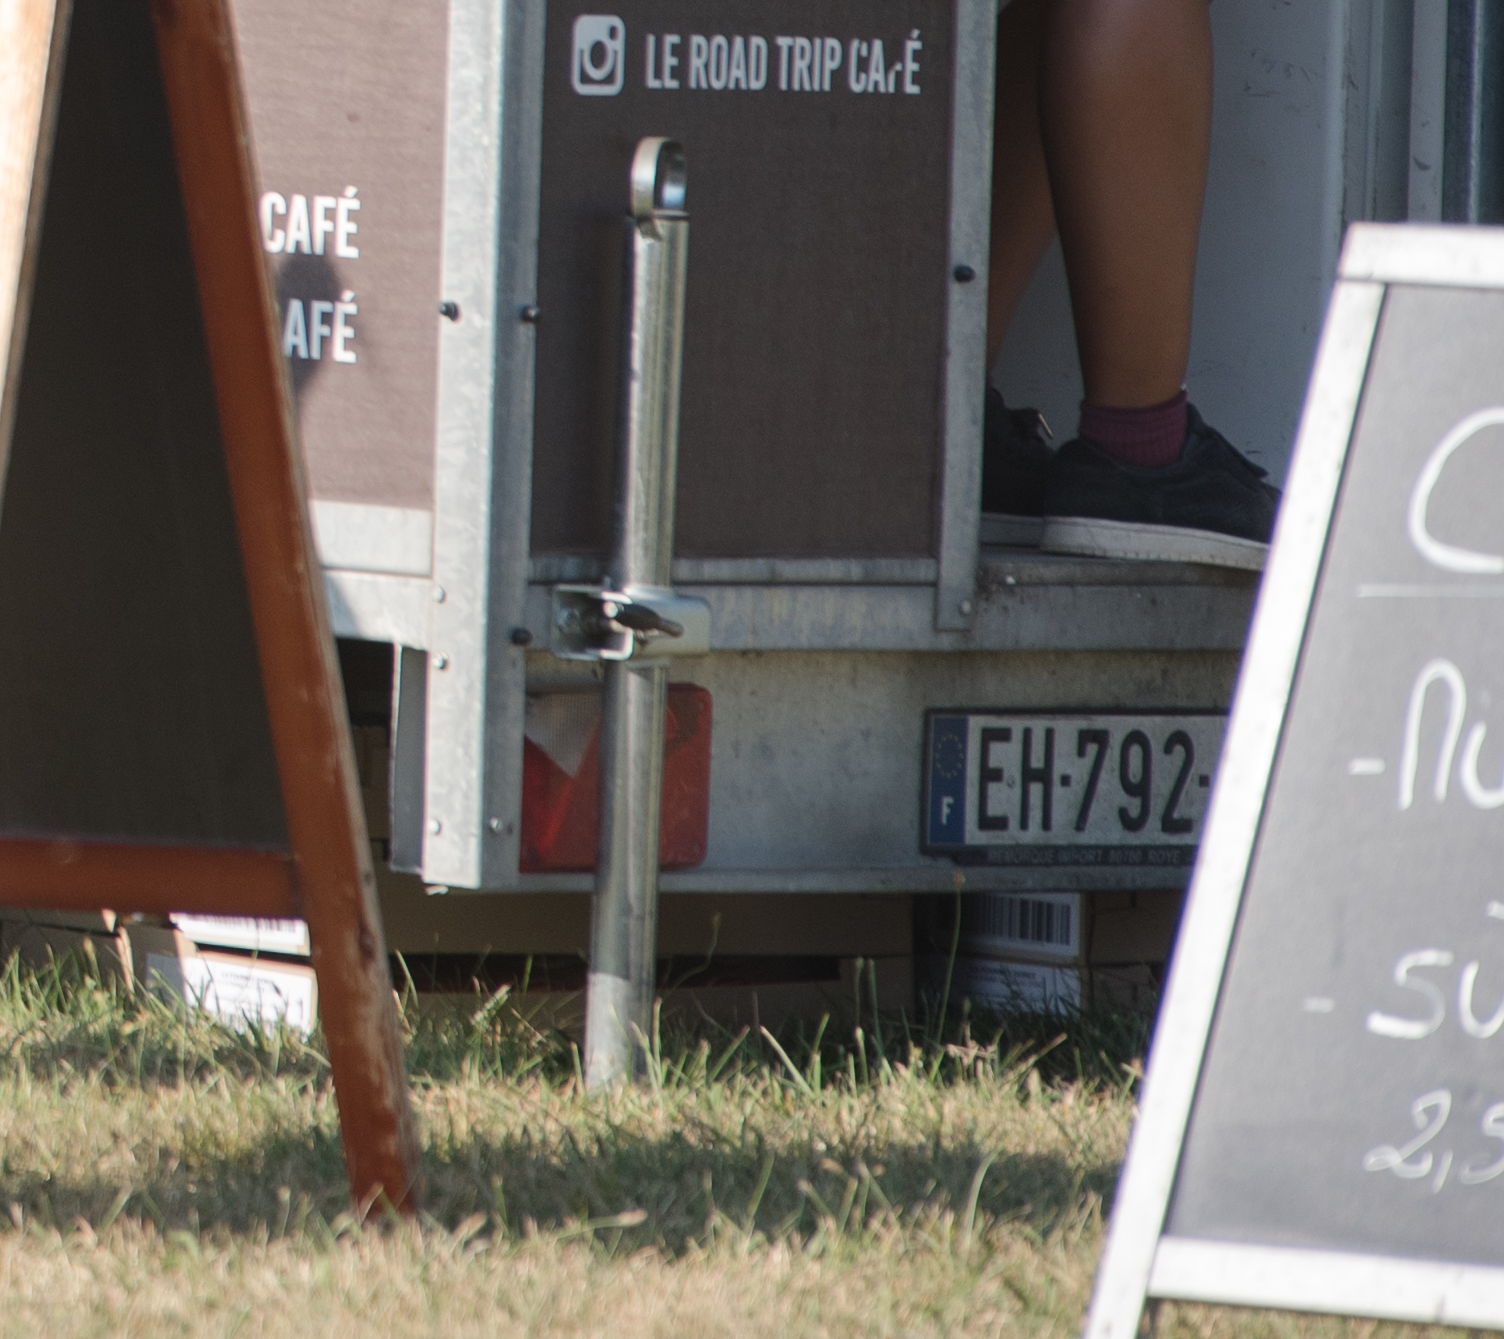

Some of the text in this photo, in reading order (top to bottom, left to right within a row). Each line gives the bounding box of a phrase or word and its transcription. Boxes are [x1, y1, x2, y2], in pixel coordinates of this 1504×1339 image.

[645, 32, 681, 90] LE
[689, 34, 768, 91] ROAD
[775, 35, 843, 92] TRIP
[259, 184, 361, 259] CAFÉ
[280, 289, 359, 364] AFÉ
[940, 795, 955, 826] F
[977, 726, 1210, 835] EH-792-
